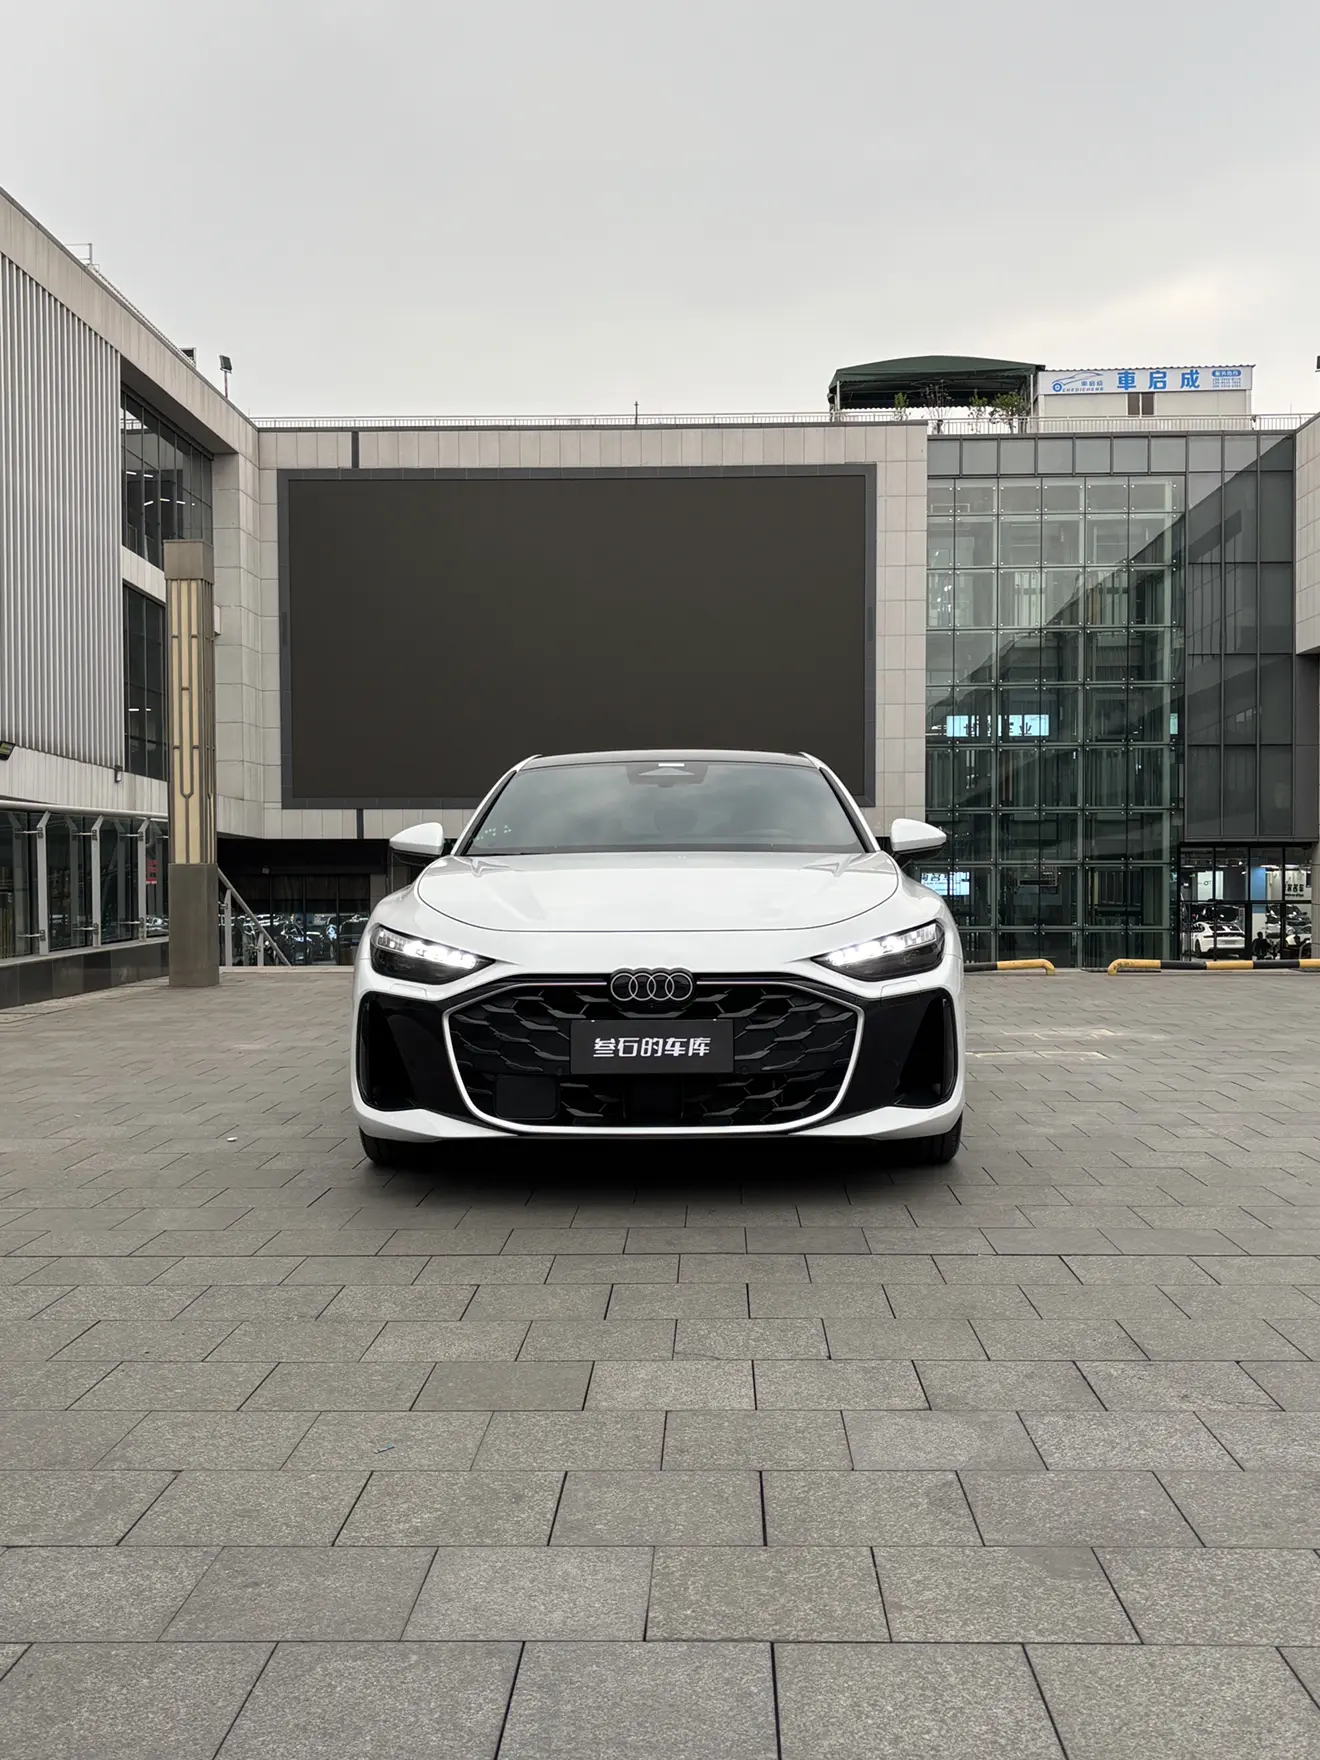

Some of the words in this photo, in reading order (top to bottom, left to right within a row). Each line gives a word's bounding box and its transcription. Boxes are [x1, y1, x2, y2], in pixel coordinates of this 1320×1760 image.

[1117, 369, 1200, 390] 車启成
[593, 1037, 711, 1057] 叁石的车库
